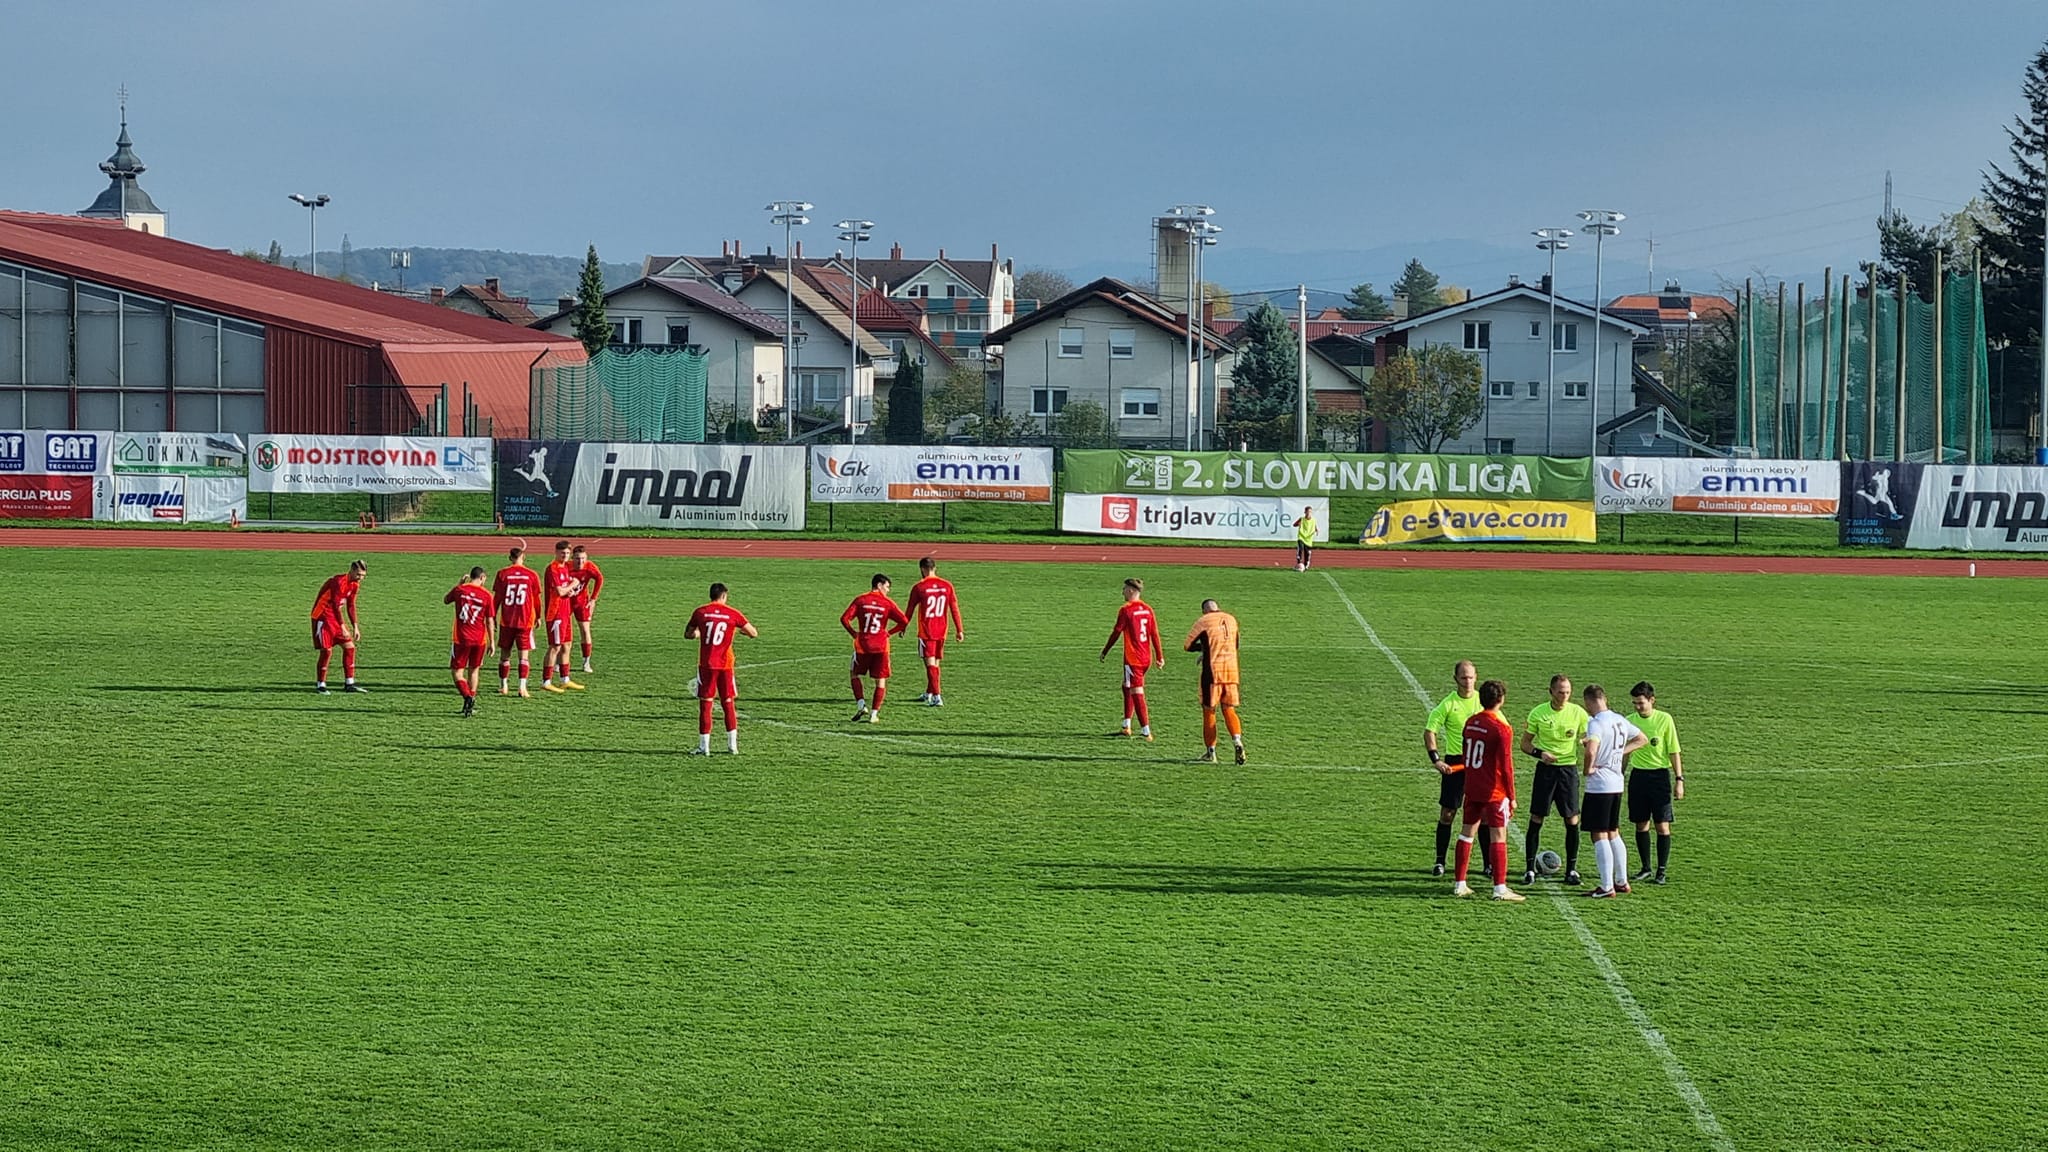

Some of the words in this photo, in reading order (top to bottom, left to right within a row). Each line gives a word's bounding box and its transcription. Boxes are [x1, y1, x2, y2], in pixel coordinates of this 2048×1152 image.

[0, 436, 22, 458] AT
[48, 437, 94, 459] GAT
[147, 445, 198, 462] OKNA
[288, 447, 437, 467] MOJSTROVINA
[917, 453, 979, 461] aluminium
[840, 461, 870, 477] Gk
[917, 462, 1020, 480] emmi
[1157, 458, 1169, 487] LIGA
[1182, 459, 1213, 489] 2.
[1223, 458, 1438, 492] SLOVENSKA
[1448, 463, 1531, 494] LIGA
[1702, 465, 1764, 473] aluminium
[283, 474, 302, 483] CNC
[305, 474, 353, 487] Machining
[361, 475, 457, 487] www.mojstrovina.si
[596, 453, 752, 519] impol
[817, 483, 852, 496] Grupa
[1623, 473, 1655, 489] Gk
[1702, 475, 1808, 493] emmi
[0, 490, 37, 500] RGIJA
[40, 490, 72, 501] PLUS
[912, 488, 961, 498] Aluminiju
[964, 488, 1000, 499] dajemo
[1003, 489, 1026, 500] sijaj
[1600, 495, 1636, 508] Grupa
[674, 509, 737, 521] Aluminium
[740, 510, 788, 524] Industry
[1697, 500, 1747, 511] Aluminiju
[1750, 500, 1787, 512] dajemo
[1790, 501, 1813, 513] sijaj
[1941, 475, 2048, 542] imp
[1401, 509, 1568, 531] e-stave.com
[2020, 532, 2048, 543] Alum
[505, 583, 528, 606] 55
[458, 603, 482, 624] 47
[925, 595, 946, 618] 20
[705, 621, 727, 646] 16
[864, 613, 882, 634] 15
[1139, 618, 1148, 642] 5
[1219, 617, 1230, 640] 1
[1611, 723, 1625, 749] 15
[1465, 738, 1485, 769] 10
